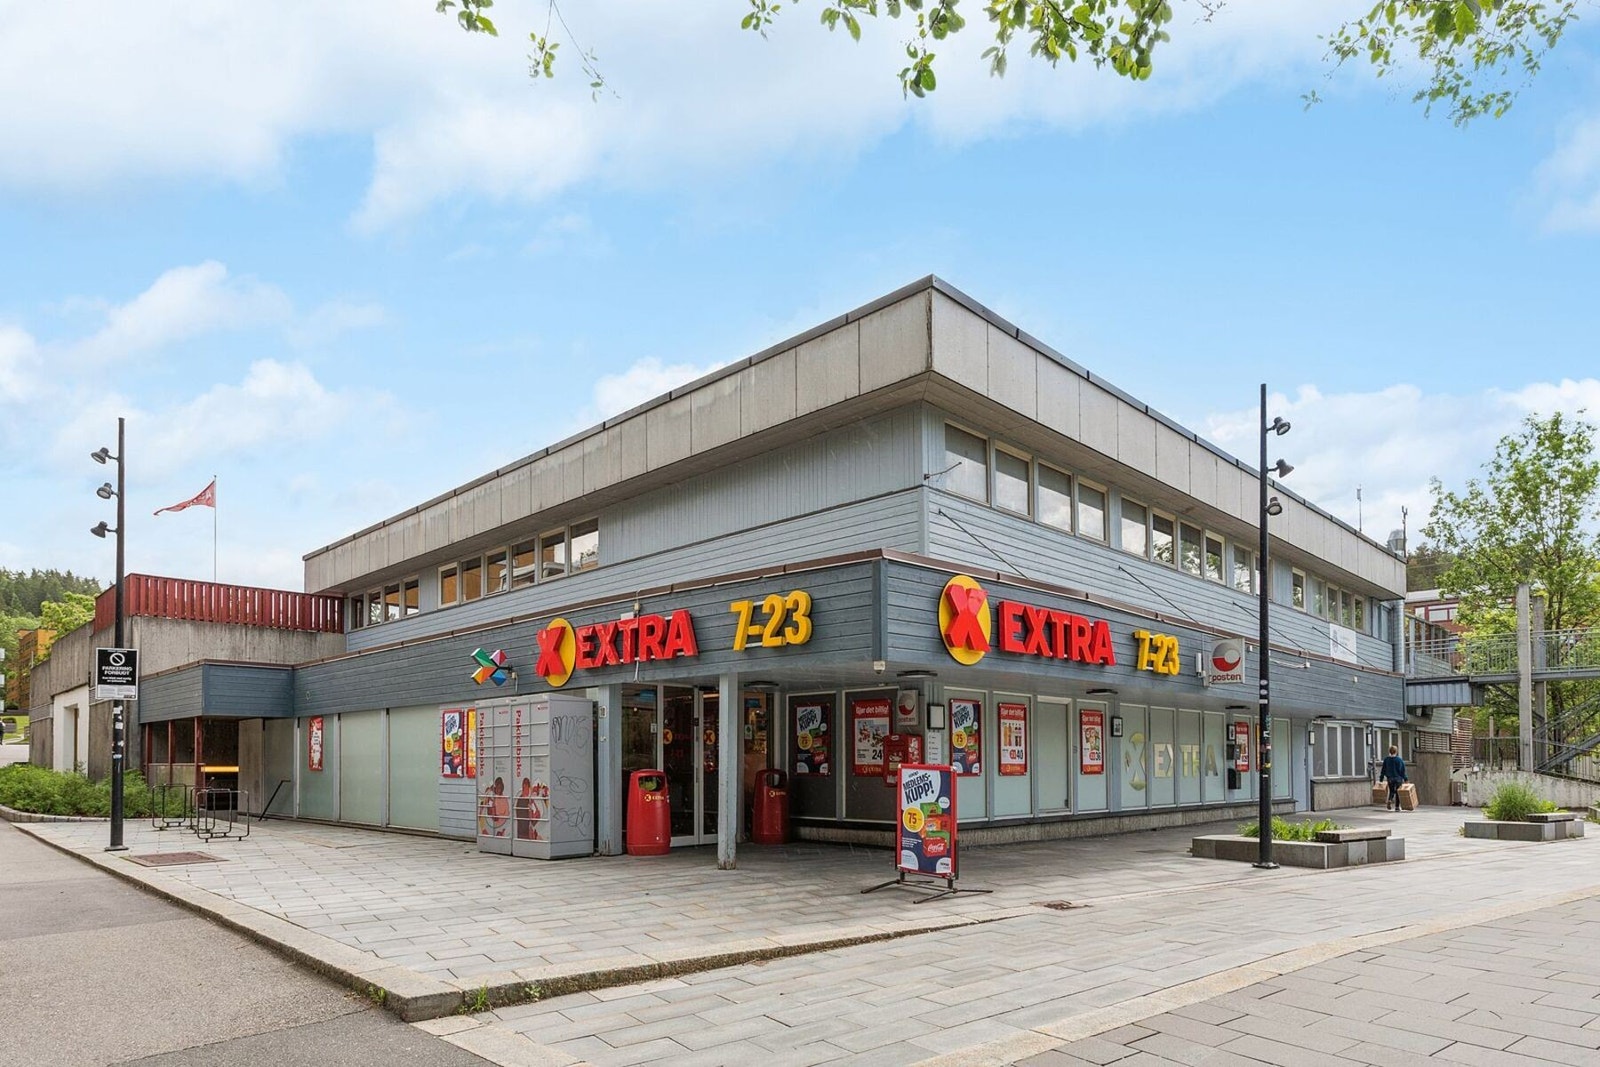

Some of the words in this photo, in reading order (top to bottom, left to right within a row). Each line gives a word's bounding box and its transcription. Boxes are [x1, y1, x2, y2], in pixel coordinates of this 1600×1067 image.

[730, 590, 812, 651] 7-23
[944, 584, 991, 652] X
[998, 600, 1117, 666] EXTRA
[535, 626, 567, 677] X
[575, 608, 698, 670] EXTRA
[1134, 629, 1180, 676] 7-23
[1212, 673, 1241, 683] posten
[903, 772, 931, 790] MEDLEMS-
[905, 780, 934, 804] KUPP!
[908, 812, 918, 825] 75
